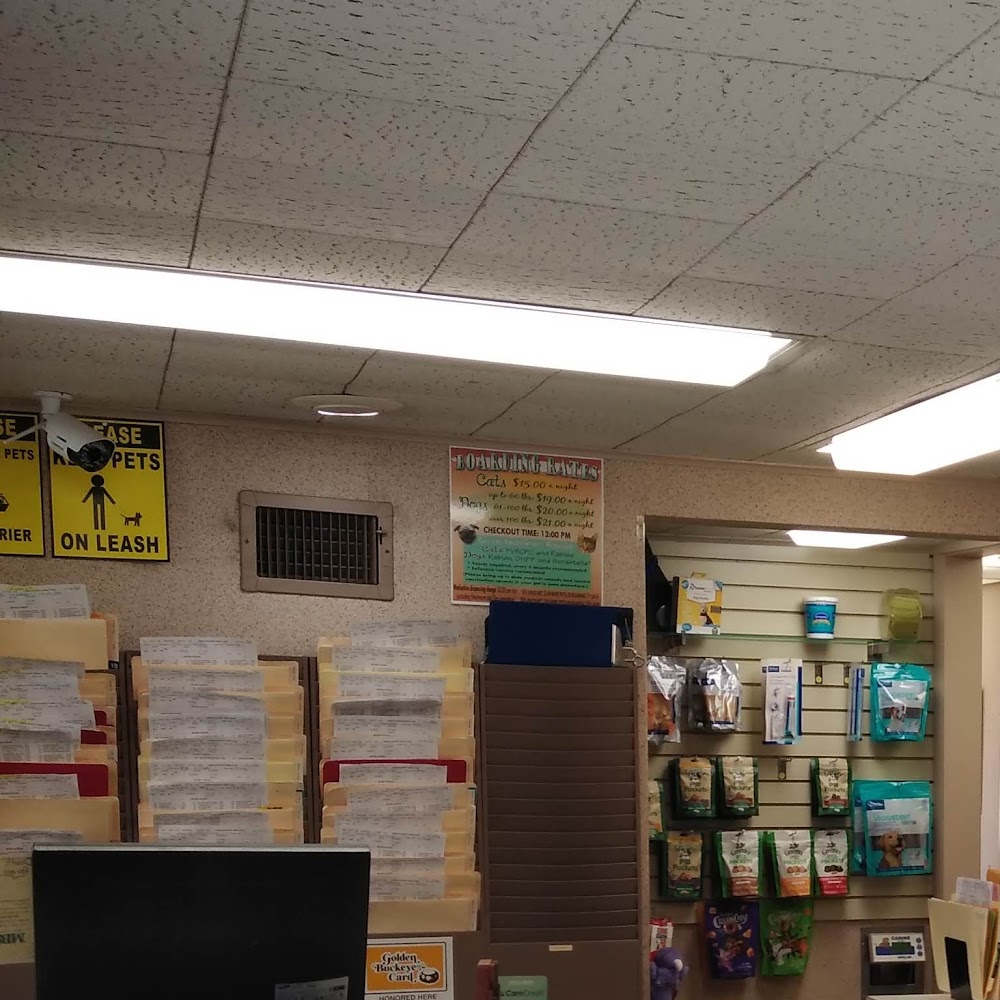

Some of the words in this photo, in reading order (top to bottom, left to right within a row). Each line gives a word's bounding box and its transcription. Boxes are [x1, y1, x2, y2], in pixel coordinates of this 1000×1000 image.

[4, 447, 35, 461] PETS
[112, 451, 161, 471] PETS
[455, 452, 540, 474] BOARDING
[546, 456, 599, 482] RATES
[476, 473, 507, 488] Cats
[513, 477, 546, 489] $15.00
[536, 493, 566, 504] $19.00
[536, 505, 567, 515] $20.00
[0, 528, 32, 542] RIER
[483, 526, 520, 536] CHECKOUT
[522, 528, 539, 537] TIME:
[541, 530, 560, 539] 12:00
[561, 531, 571, 539] PM
[61, 532, 88, 551] ON
[97, 534, 159, 554] LEASH
[381, 951, 420, 966] Golden
[372, 962, 417, 973] Buckeye
[387, 971, 418, 983] Card
